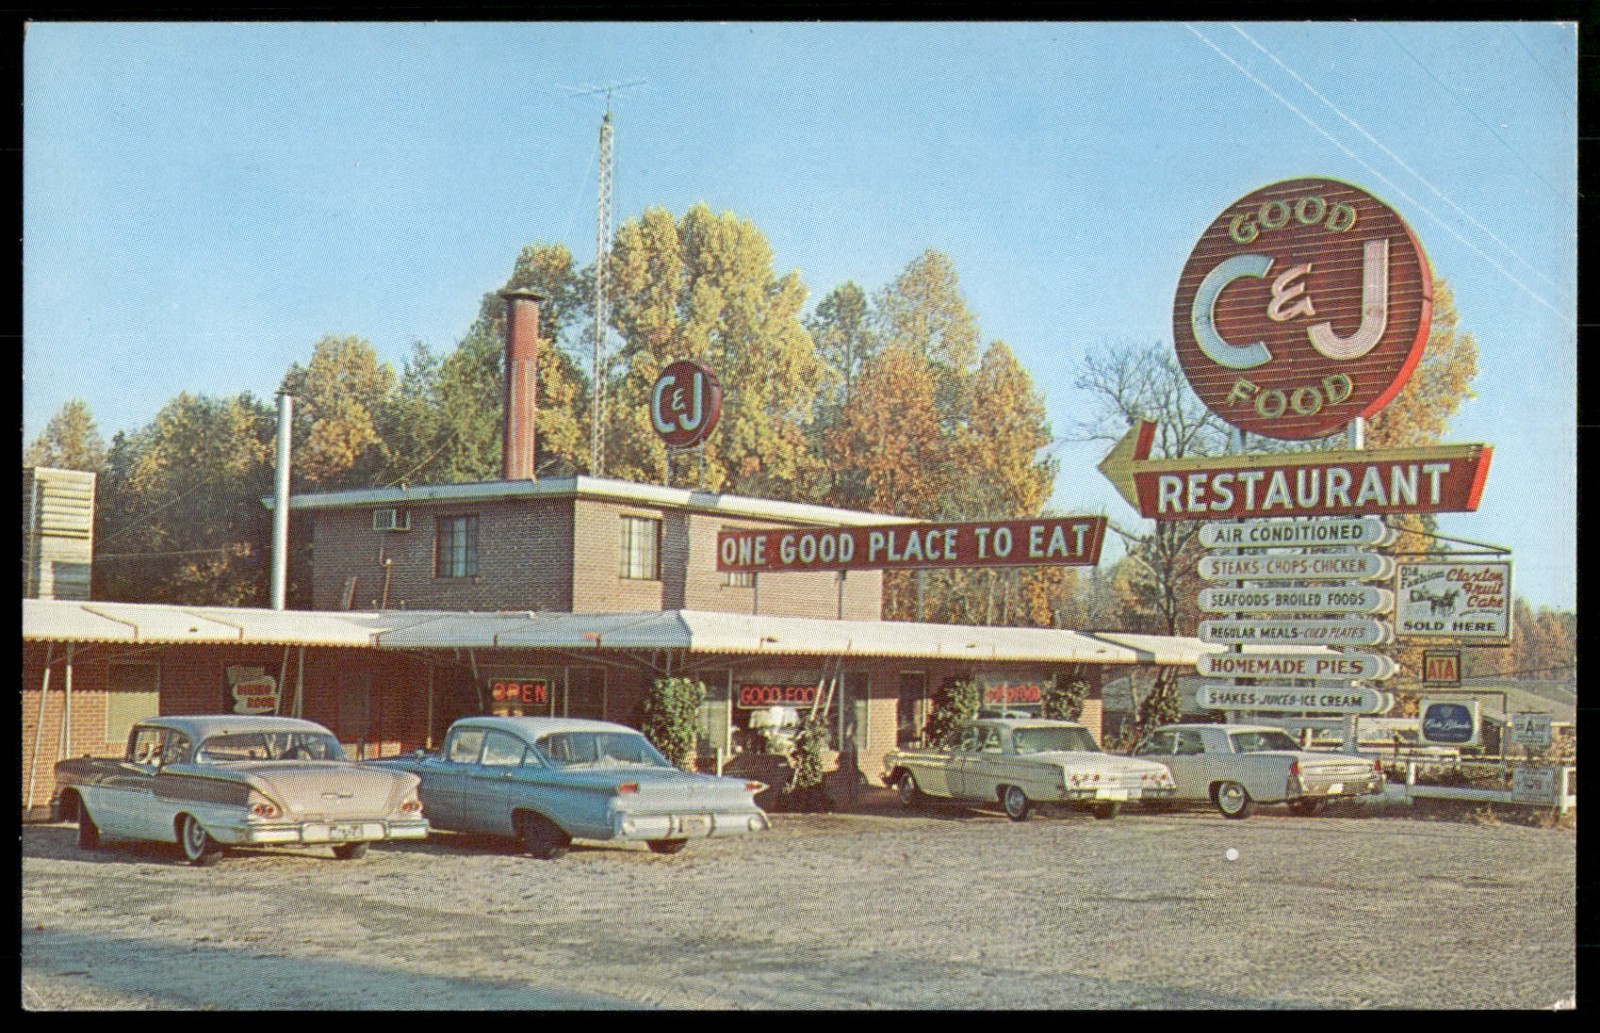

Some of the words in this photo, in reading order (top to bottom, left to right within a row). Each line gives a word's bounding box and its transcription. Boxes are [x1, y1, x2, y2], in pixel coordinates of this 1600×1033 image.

[1229, 196, 1357, 243] GOOD
[1192, 253, 1275, 369] C
[1267, 263, 1316, 322] &
[1307, 238, 1389, 361] J
[652, 376, 675, 434] C
[672, 387, 686, 411] &
[679, 372, 702, 431] J
[1228, 373, 1353, 419] FOOD
[1157, 462, 1450, 513] RESTAURANT
[1215, 527, 1242, 542] AIR
[1250, 524, 1364, 542] CONDITIONED
[720, 536, 767, 566] ONE
[780, 533, 854, 564] GOOD
[868, 528, 957, 562] PLACE
[975, 527, 1012, 559] TO
[1029, 524, 1090, 558] EAT
[1211, 561, 1260, 575] STEAKS
[1275, 593, 1322, 607] BROILED
[1328, 592, 1366, 605] FOODS
[1467, 595, 1504, 608] Cake
[1404, 621, 1444, 631] SOLD
[1452, 622, 1496, 631] HERE
[1210, 658, 1306, 674] HOMEMADE
[1316, 659, 1364, 674] PIES
[1427, 659, 1455, 679] ATA
[492, 682, 546, 702] OPEN
[740, 686, 782, 704] GOOD
[1320, 695, 1362, 707] CREAM
